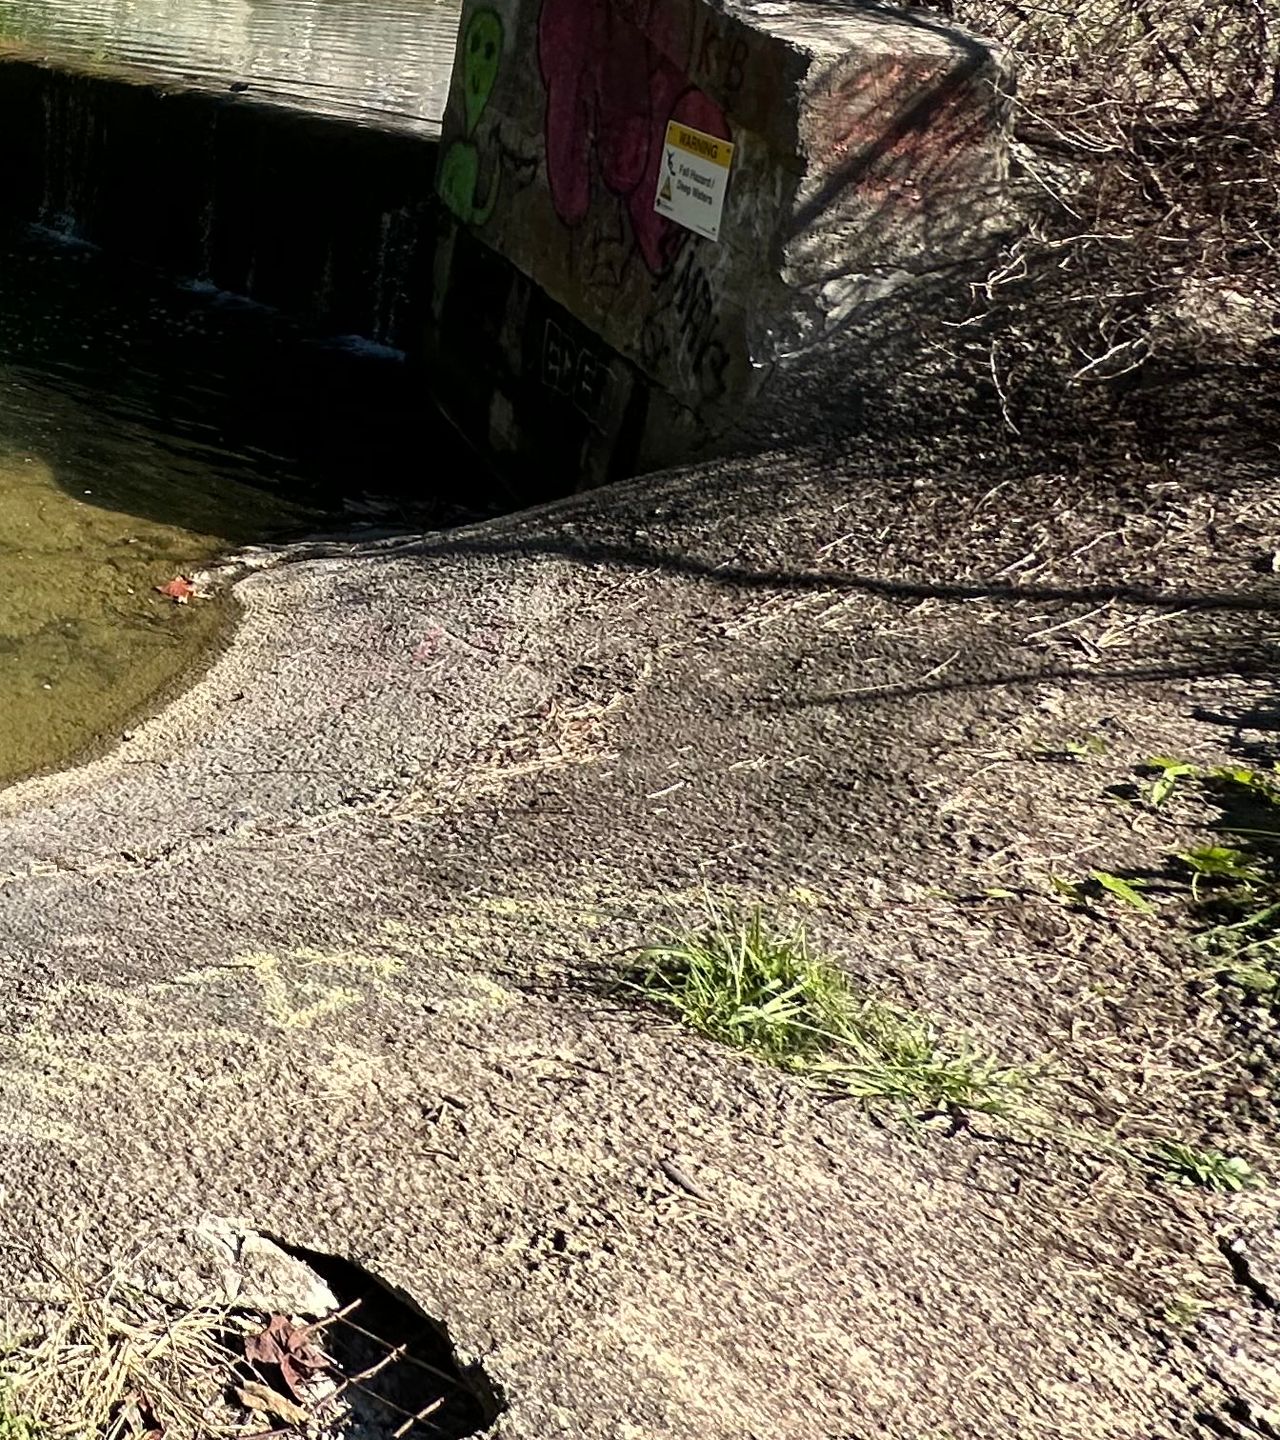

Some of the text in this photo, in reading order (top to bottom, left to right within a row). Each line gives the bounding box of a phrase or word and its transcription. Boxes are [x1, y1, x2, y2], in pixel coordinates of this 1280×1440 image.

[679, 132, 718, 158] WARNING
[679, 164, 690, 177] Fall
[690, 168, 711, 187] Hazard
[677, 180, 691, 196] Deep
